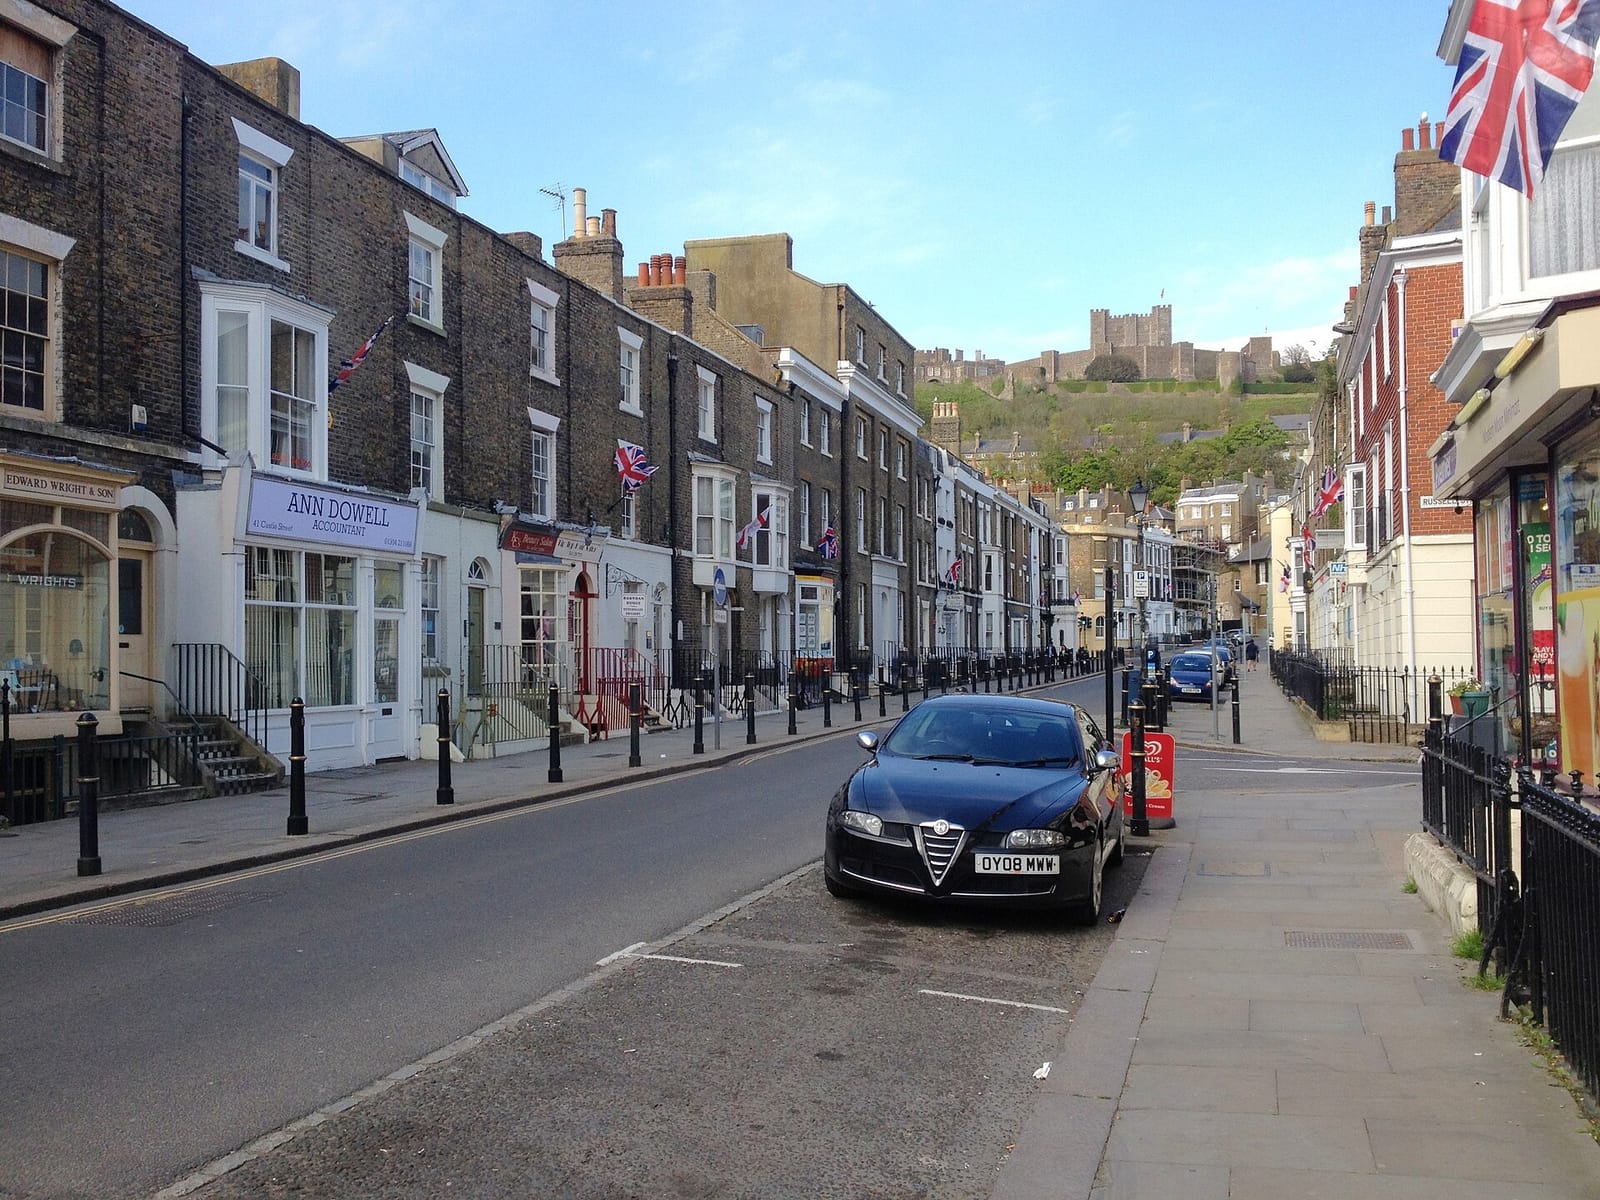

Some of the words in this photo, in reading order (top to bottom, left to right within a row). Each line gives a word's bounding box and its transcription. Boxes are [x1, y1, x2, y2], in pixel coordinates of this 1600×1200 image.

[6, 474, 48, 489] EDWARD
[50, 480, 88, 495] WRIGHT
[89, 487, 96, 497] &
[97, 488, 114, 498] SON
[287, 492, 324, 517] ANN
[328, 499, 390, 527] DOWELL
[312, 519, 367, 537] ACCOUNTANT
[18, 574, 77, 588] WRIGHTS
[1147, 650, 1154, 660] P
[982, 856, 1022, 871] OY08
[1026, 857, 1054, 872] MWW
